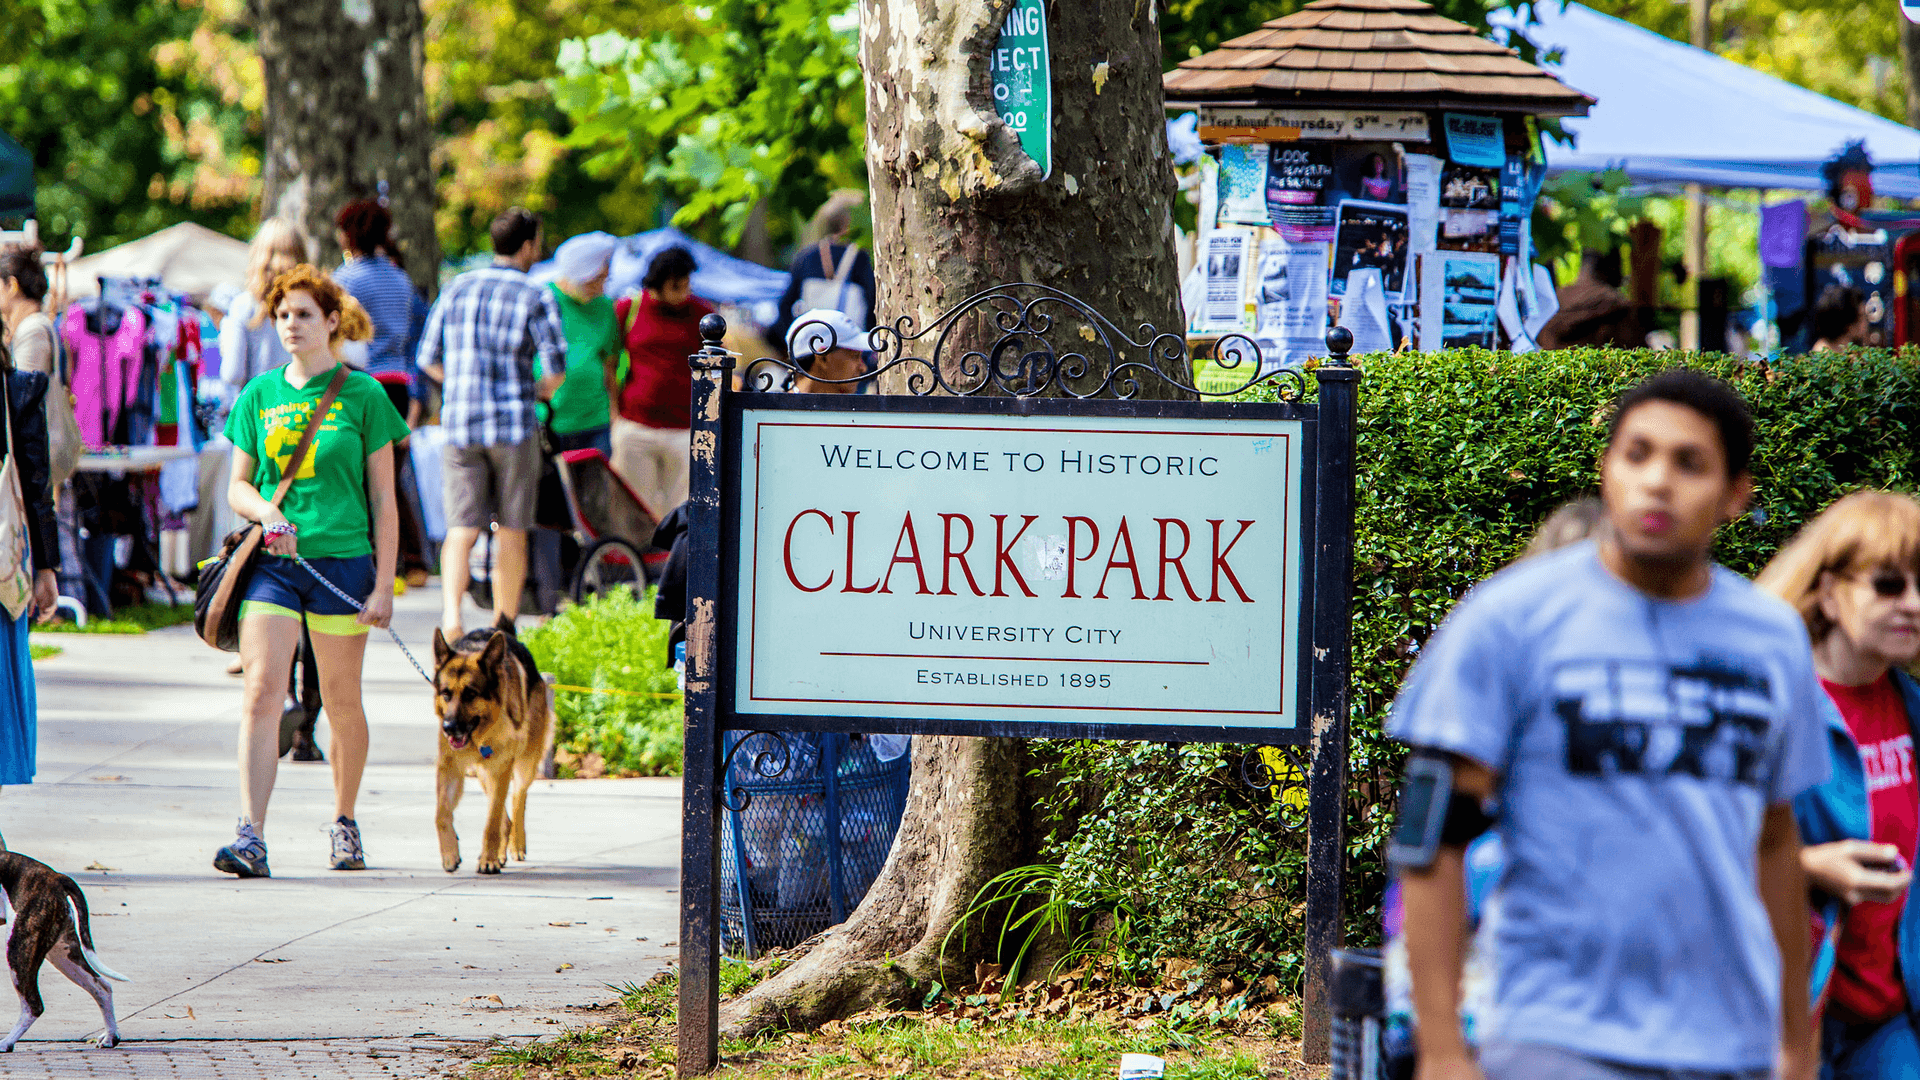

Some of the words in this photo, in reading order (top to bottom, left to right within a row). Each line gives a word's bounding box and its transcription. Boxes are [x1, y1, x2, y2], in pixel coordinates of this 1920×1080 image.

[1000, 6, 1040, 37] ING
[1274, 116, 1344, 134] Thursday
[1273, 148, 1310, 164] LOOK
[259, 401, 310, 420] Nothing
[820, 444, 990, 473] WELCOME
[1003, 452, 1045, 473] TO
[1061, 450, 1220, 477] HISTORIC
[783, 508, 1040, 598] CLARK
[1060, 515, 1256, 603] PARK
[908, 621, 1055, 643] UNIVERSITY
[1065, 625, 1122, 645] CITY
[916, 669, 1049, 687] ESTABLISHED
[1060, 673, 1112, 689] 1895
